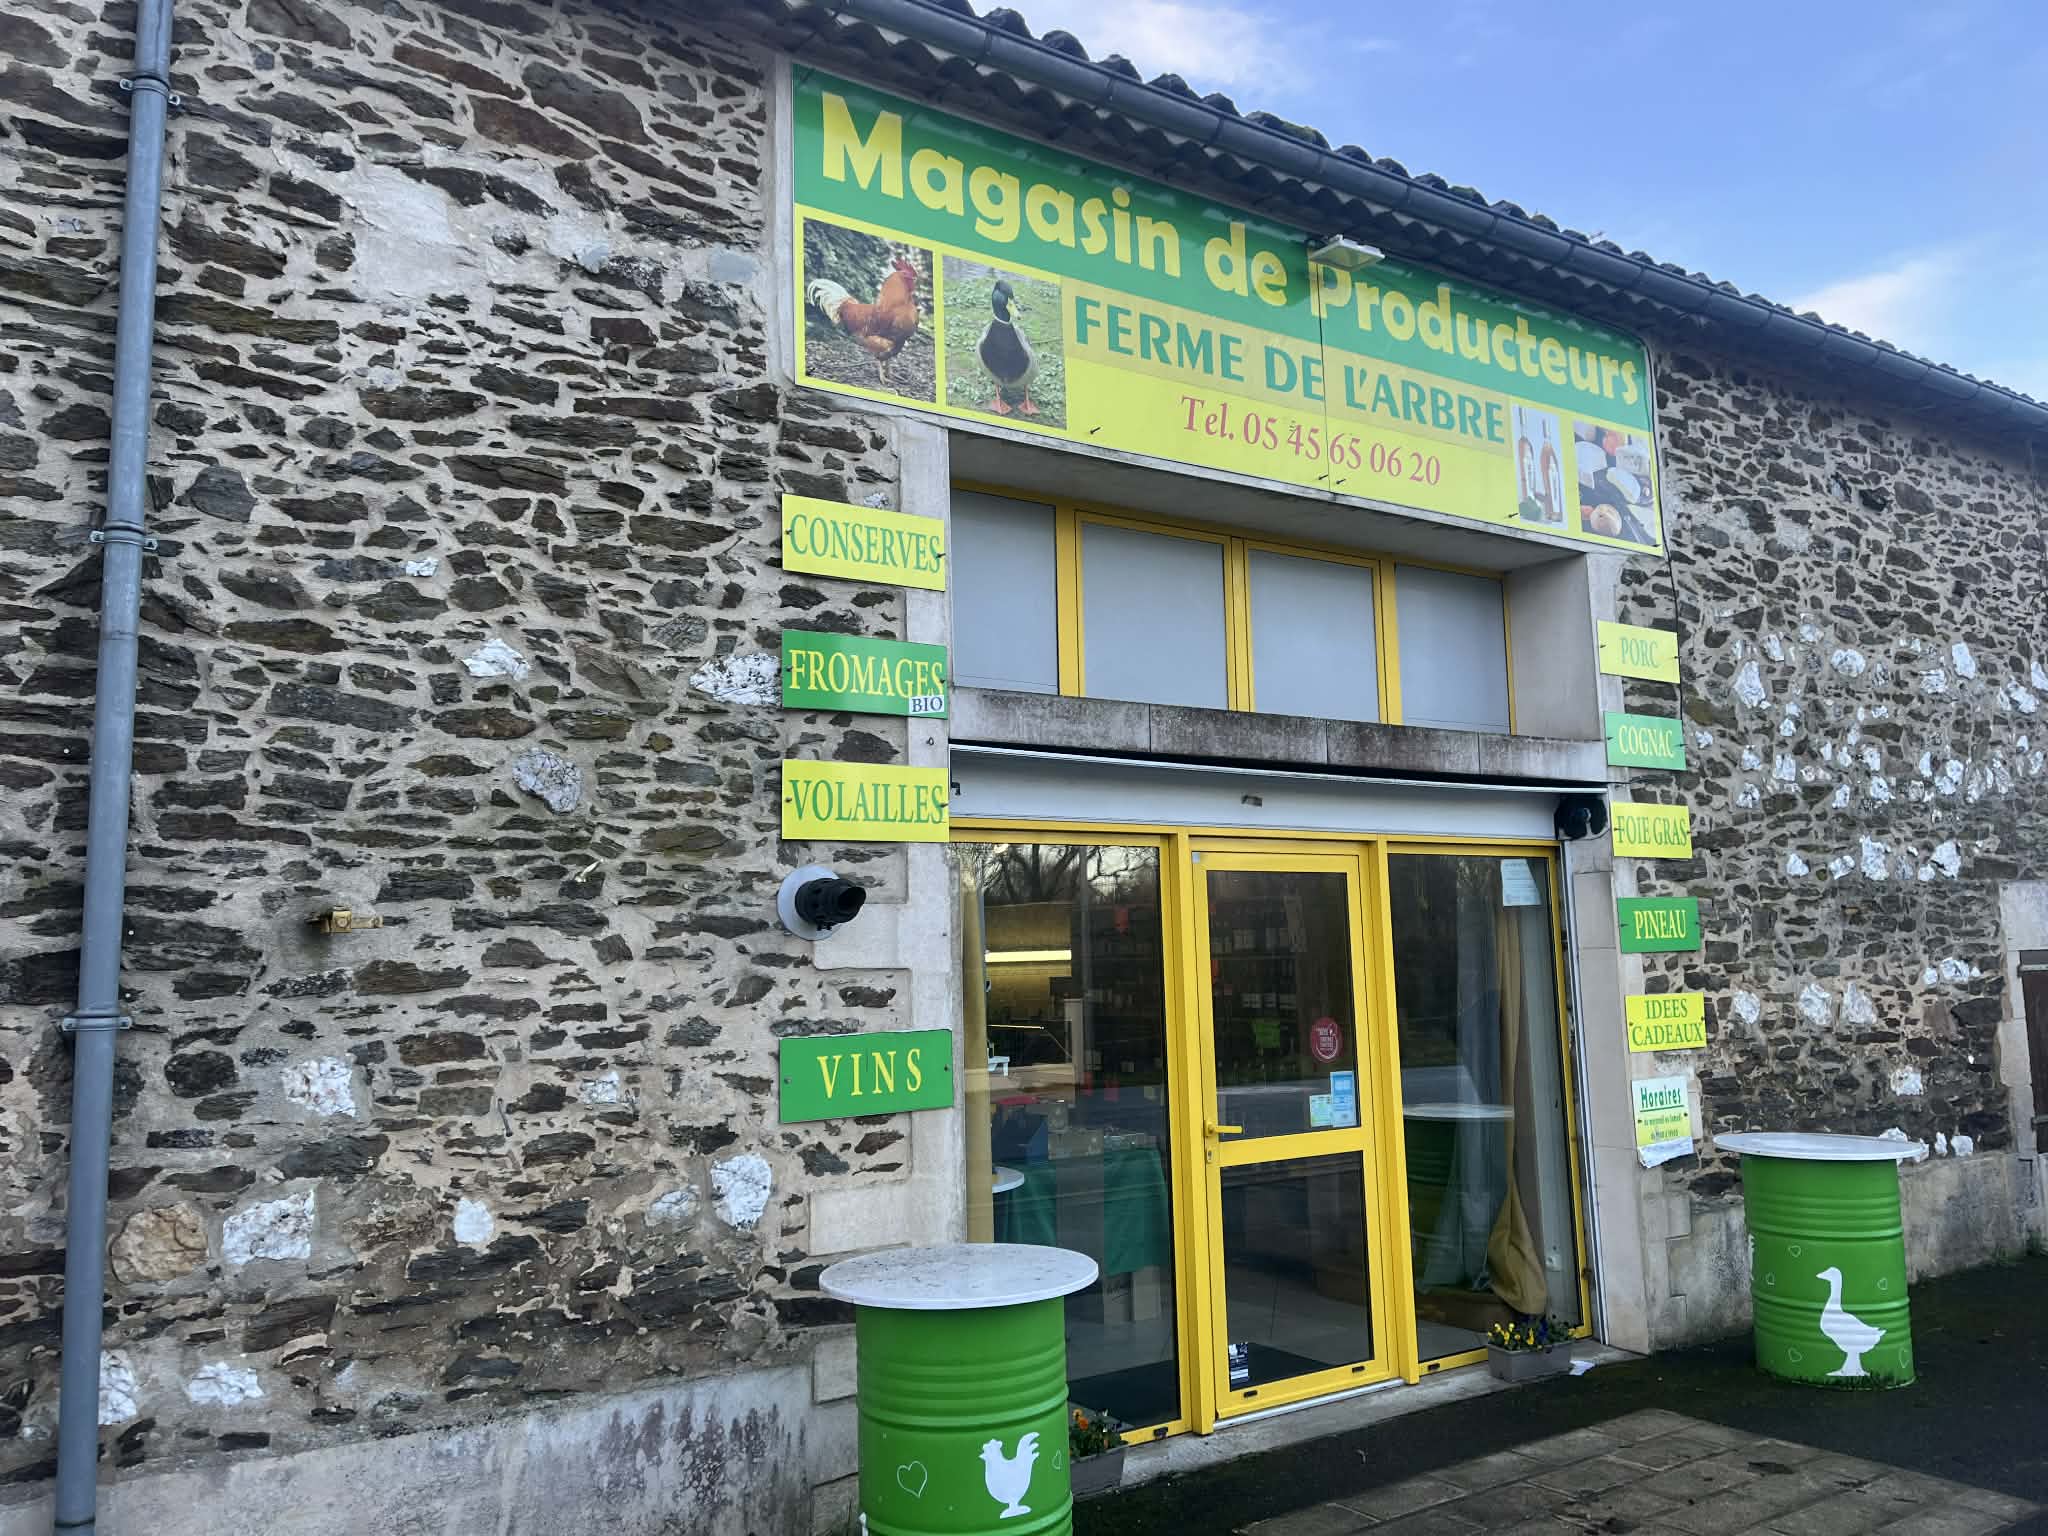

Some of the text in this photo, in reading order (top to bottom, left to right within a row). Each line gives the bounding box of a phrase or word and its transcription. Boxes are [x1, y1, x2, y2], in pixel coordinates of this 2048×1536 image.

[822, 90, 1639, 406] Magasin de Producteurs
[1075, 295, 1505, 444] FERME DE L'ARBRE
[1181, 396, 1441, 486] Tel. 05 45 65 06 20
[790, 513, 941, 574] CONSERVES
[1620, 637, 1659, 669] PORC
[788, 649, 944, 699] FROMAGES
[911, 697, 943, 713] BIO
[1618, 725, 1675, 758] COGNAC
[789, 779, 944, 824] VOLAILLES
[1616, 815, 1688, 846] FOIE GRAS
[1634, 909, 1687, 940] PINEAU
[1644, 998, 1688, 1020] IDEES
[1632, 1022, 1703, 1047] CADEAUX
[816, 1048, 923, 1099] VINS
[1640, 1085, 1682, 1109] Horaires
